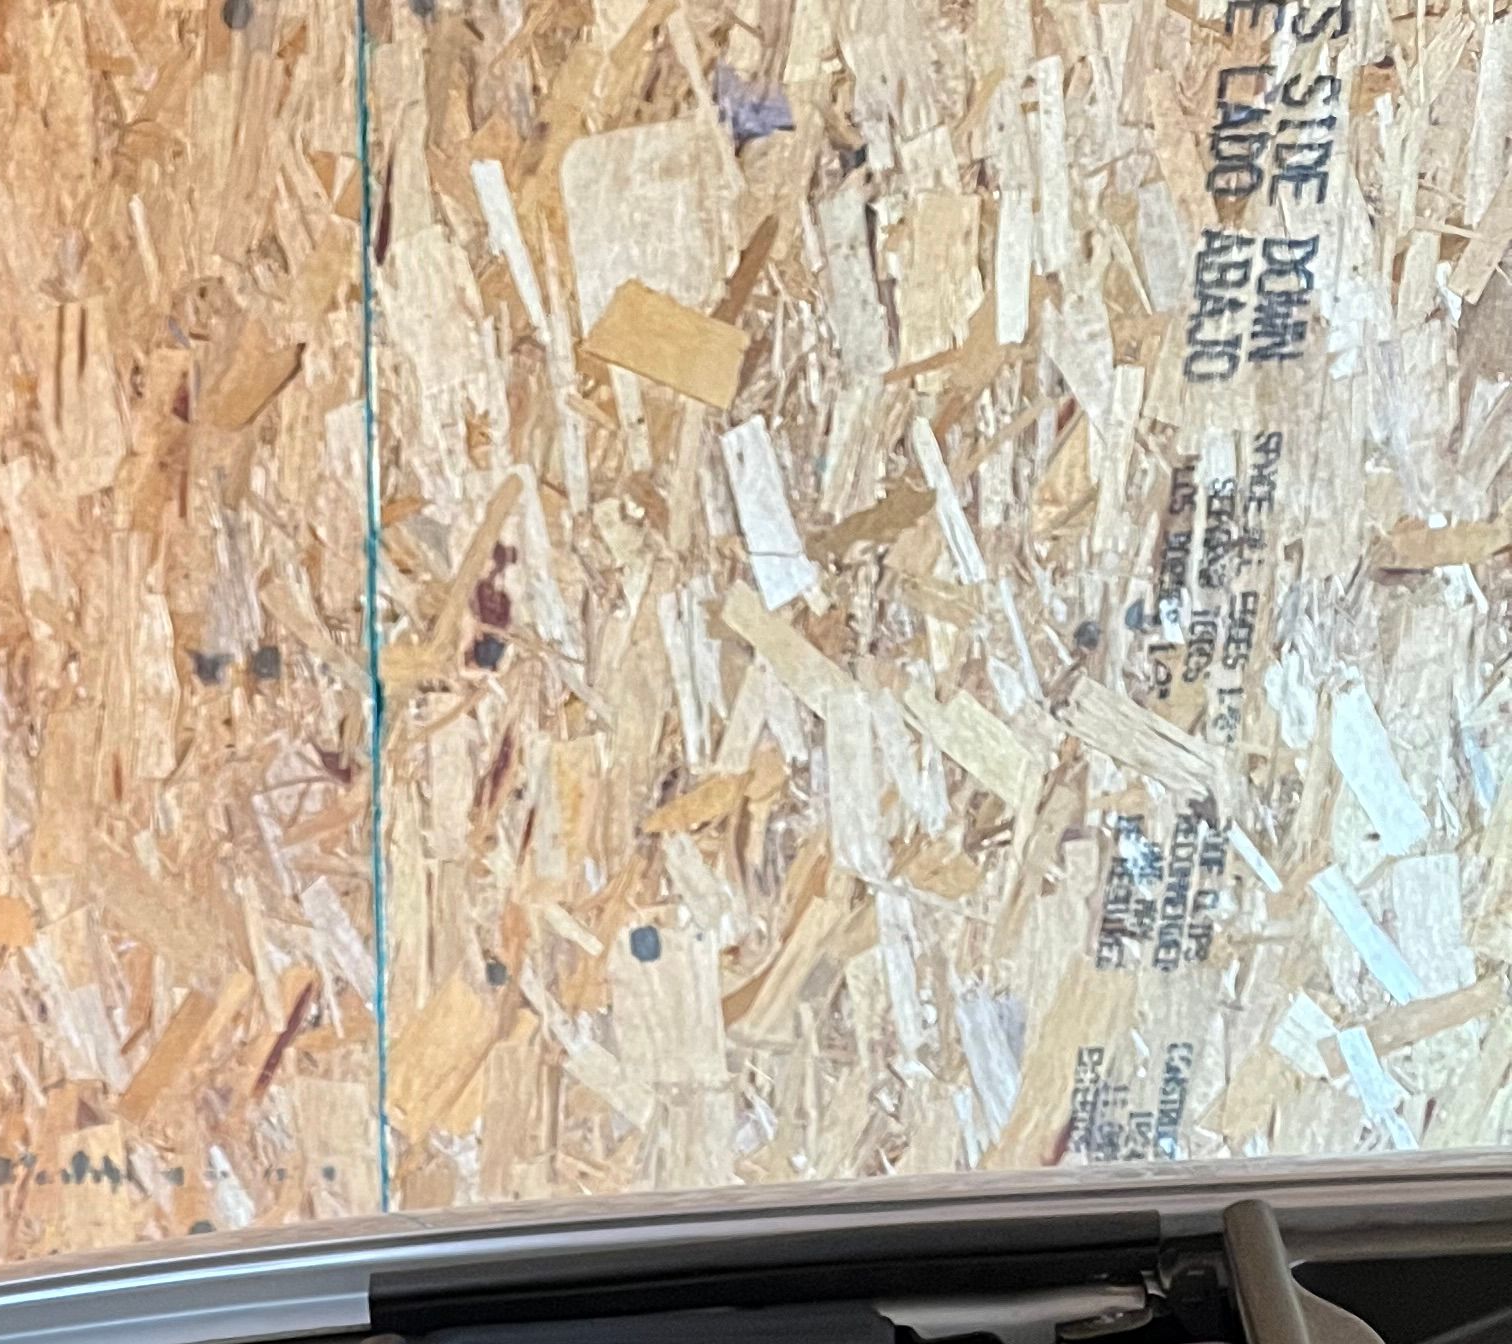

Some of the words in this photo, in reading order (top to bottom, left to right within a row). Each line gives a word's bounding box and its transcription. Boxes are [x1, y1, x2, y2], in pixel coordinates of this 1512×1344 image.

[1206, 65, 1278, 196] LADO
[1269, 73, 1342, 205] SIDE
[1184, 229, 1256, 382] ABAJO
[1248, 234, 1320, 361] DOWN
